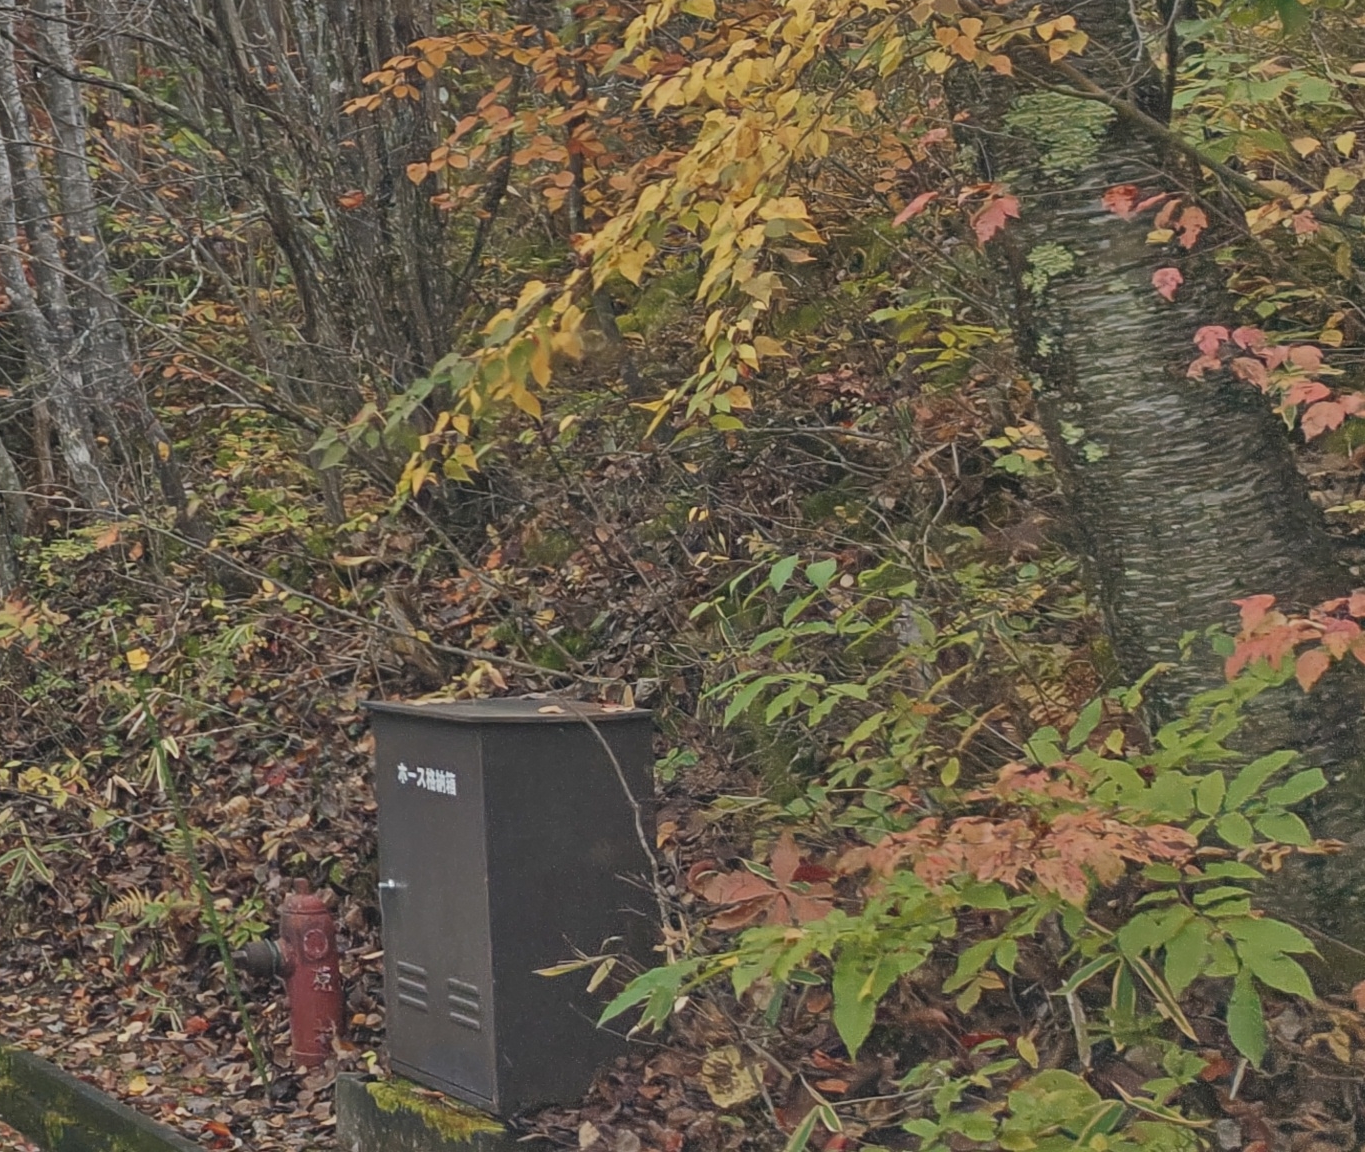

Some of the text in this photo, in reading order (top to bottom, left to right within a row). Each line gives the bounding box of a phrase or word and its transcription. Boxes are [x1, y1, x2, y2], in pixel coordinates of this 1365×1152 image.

[397, 762, 457, 796] ホース格納箱
